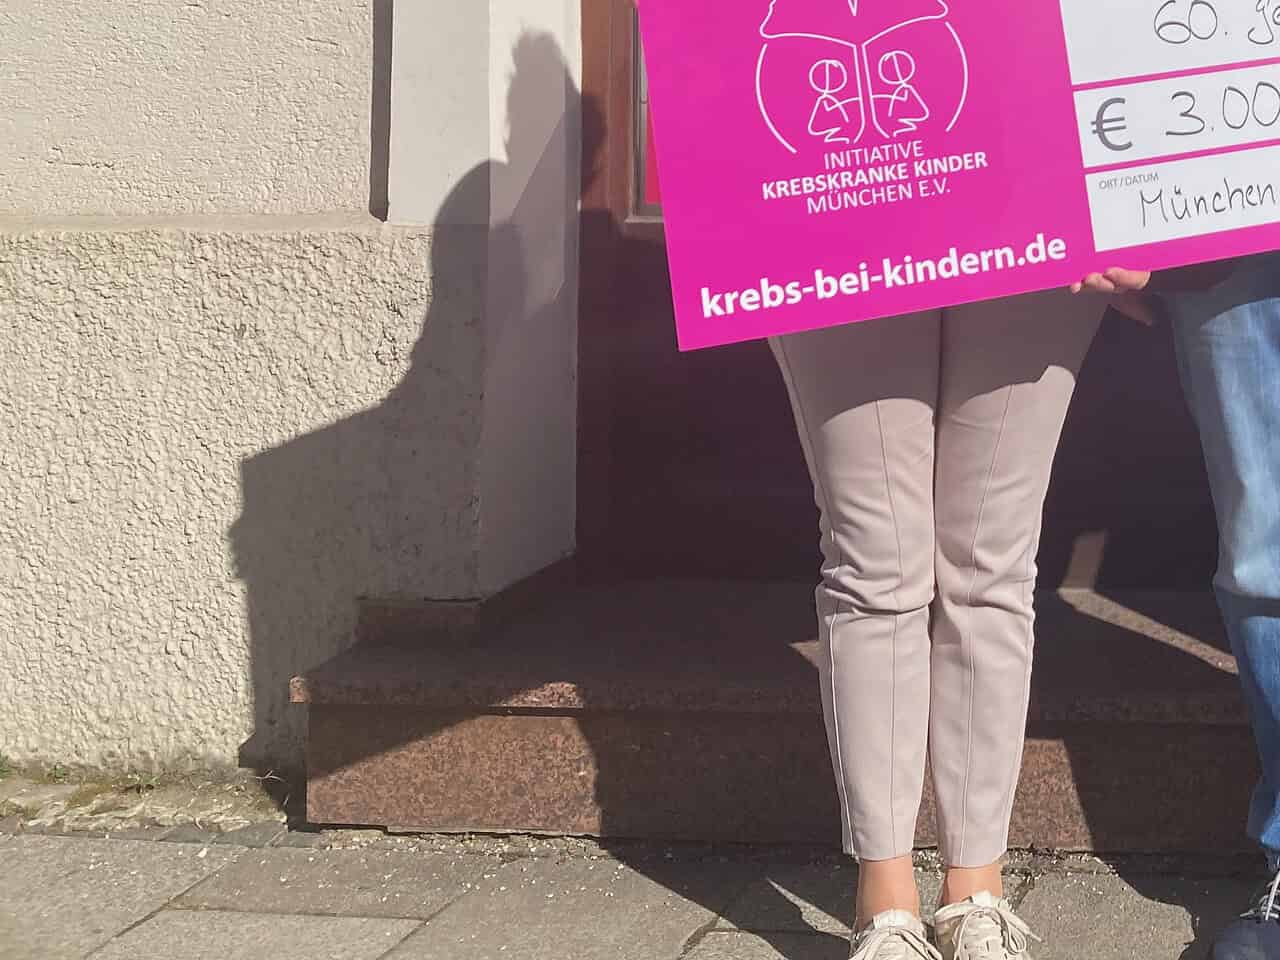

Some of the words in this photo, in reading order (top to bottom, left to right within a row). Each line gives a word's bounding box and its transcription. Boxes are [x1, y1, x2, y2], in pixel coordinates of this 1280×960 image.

[1153, 0, 1228, 45] 60.
[762, 162, 909, 201] KREBSKRANKE
[914, 151, 988, 178] KINDER
[824, 140, 924, 170] INITIATIVE
[806, 182, 913, 215] MÜNCHEN
[918, 177, 951, 198] E.V.
[701, 233, 1067, 318] krebs-bei-kindern.de
